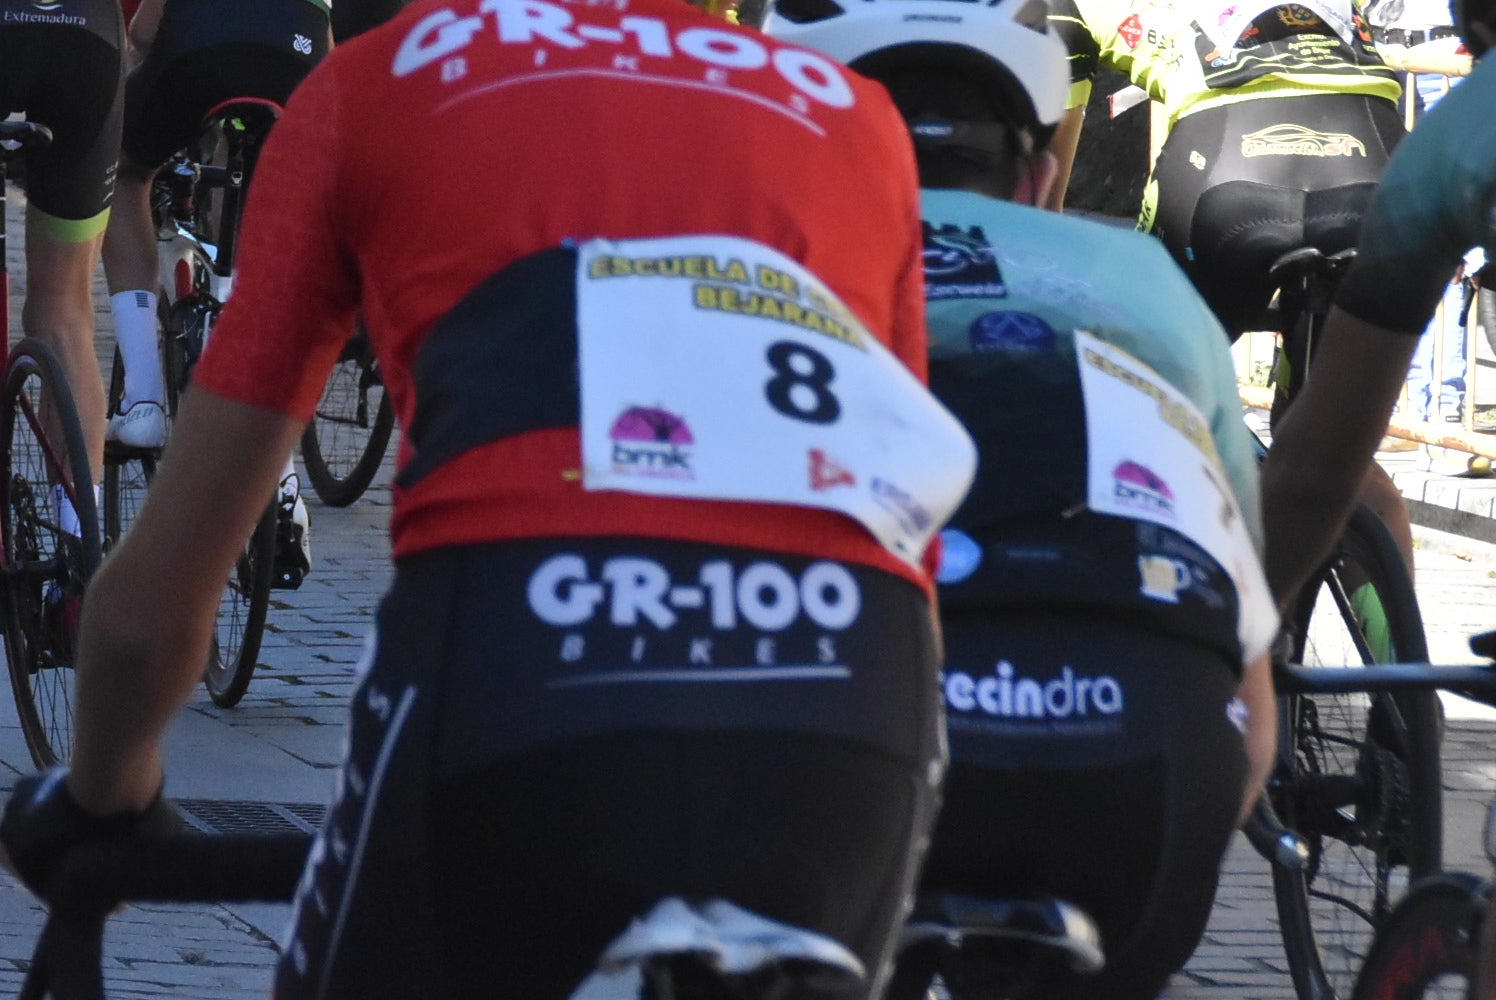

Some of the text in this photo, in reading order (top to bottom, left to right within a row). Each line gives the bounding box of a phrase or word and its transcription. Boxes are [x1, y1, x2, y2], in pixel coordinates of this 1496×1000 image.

[4, 10, 87, 26] Extremadura
[440, 48, 811, 117] BIKES
[589, 255, 799, 296] ESCUELA DE
[764, 339, 843, 426] 8
[611, 442, 690, 469] bmk
[527, 552, 862, 632] GR-100
[560, 635, 837, 665] BIKES
